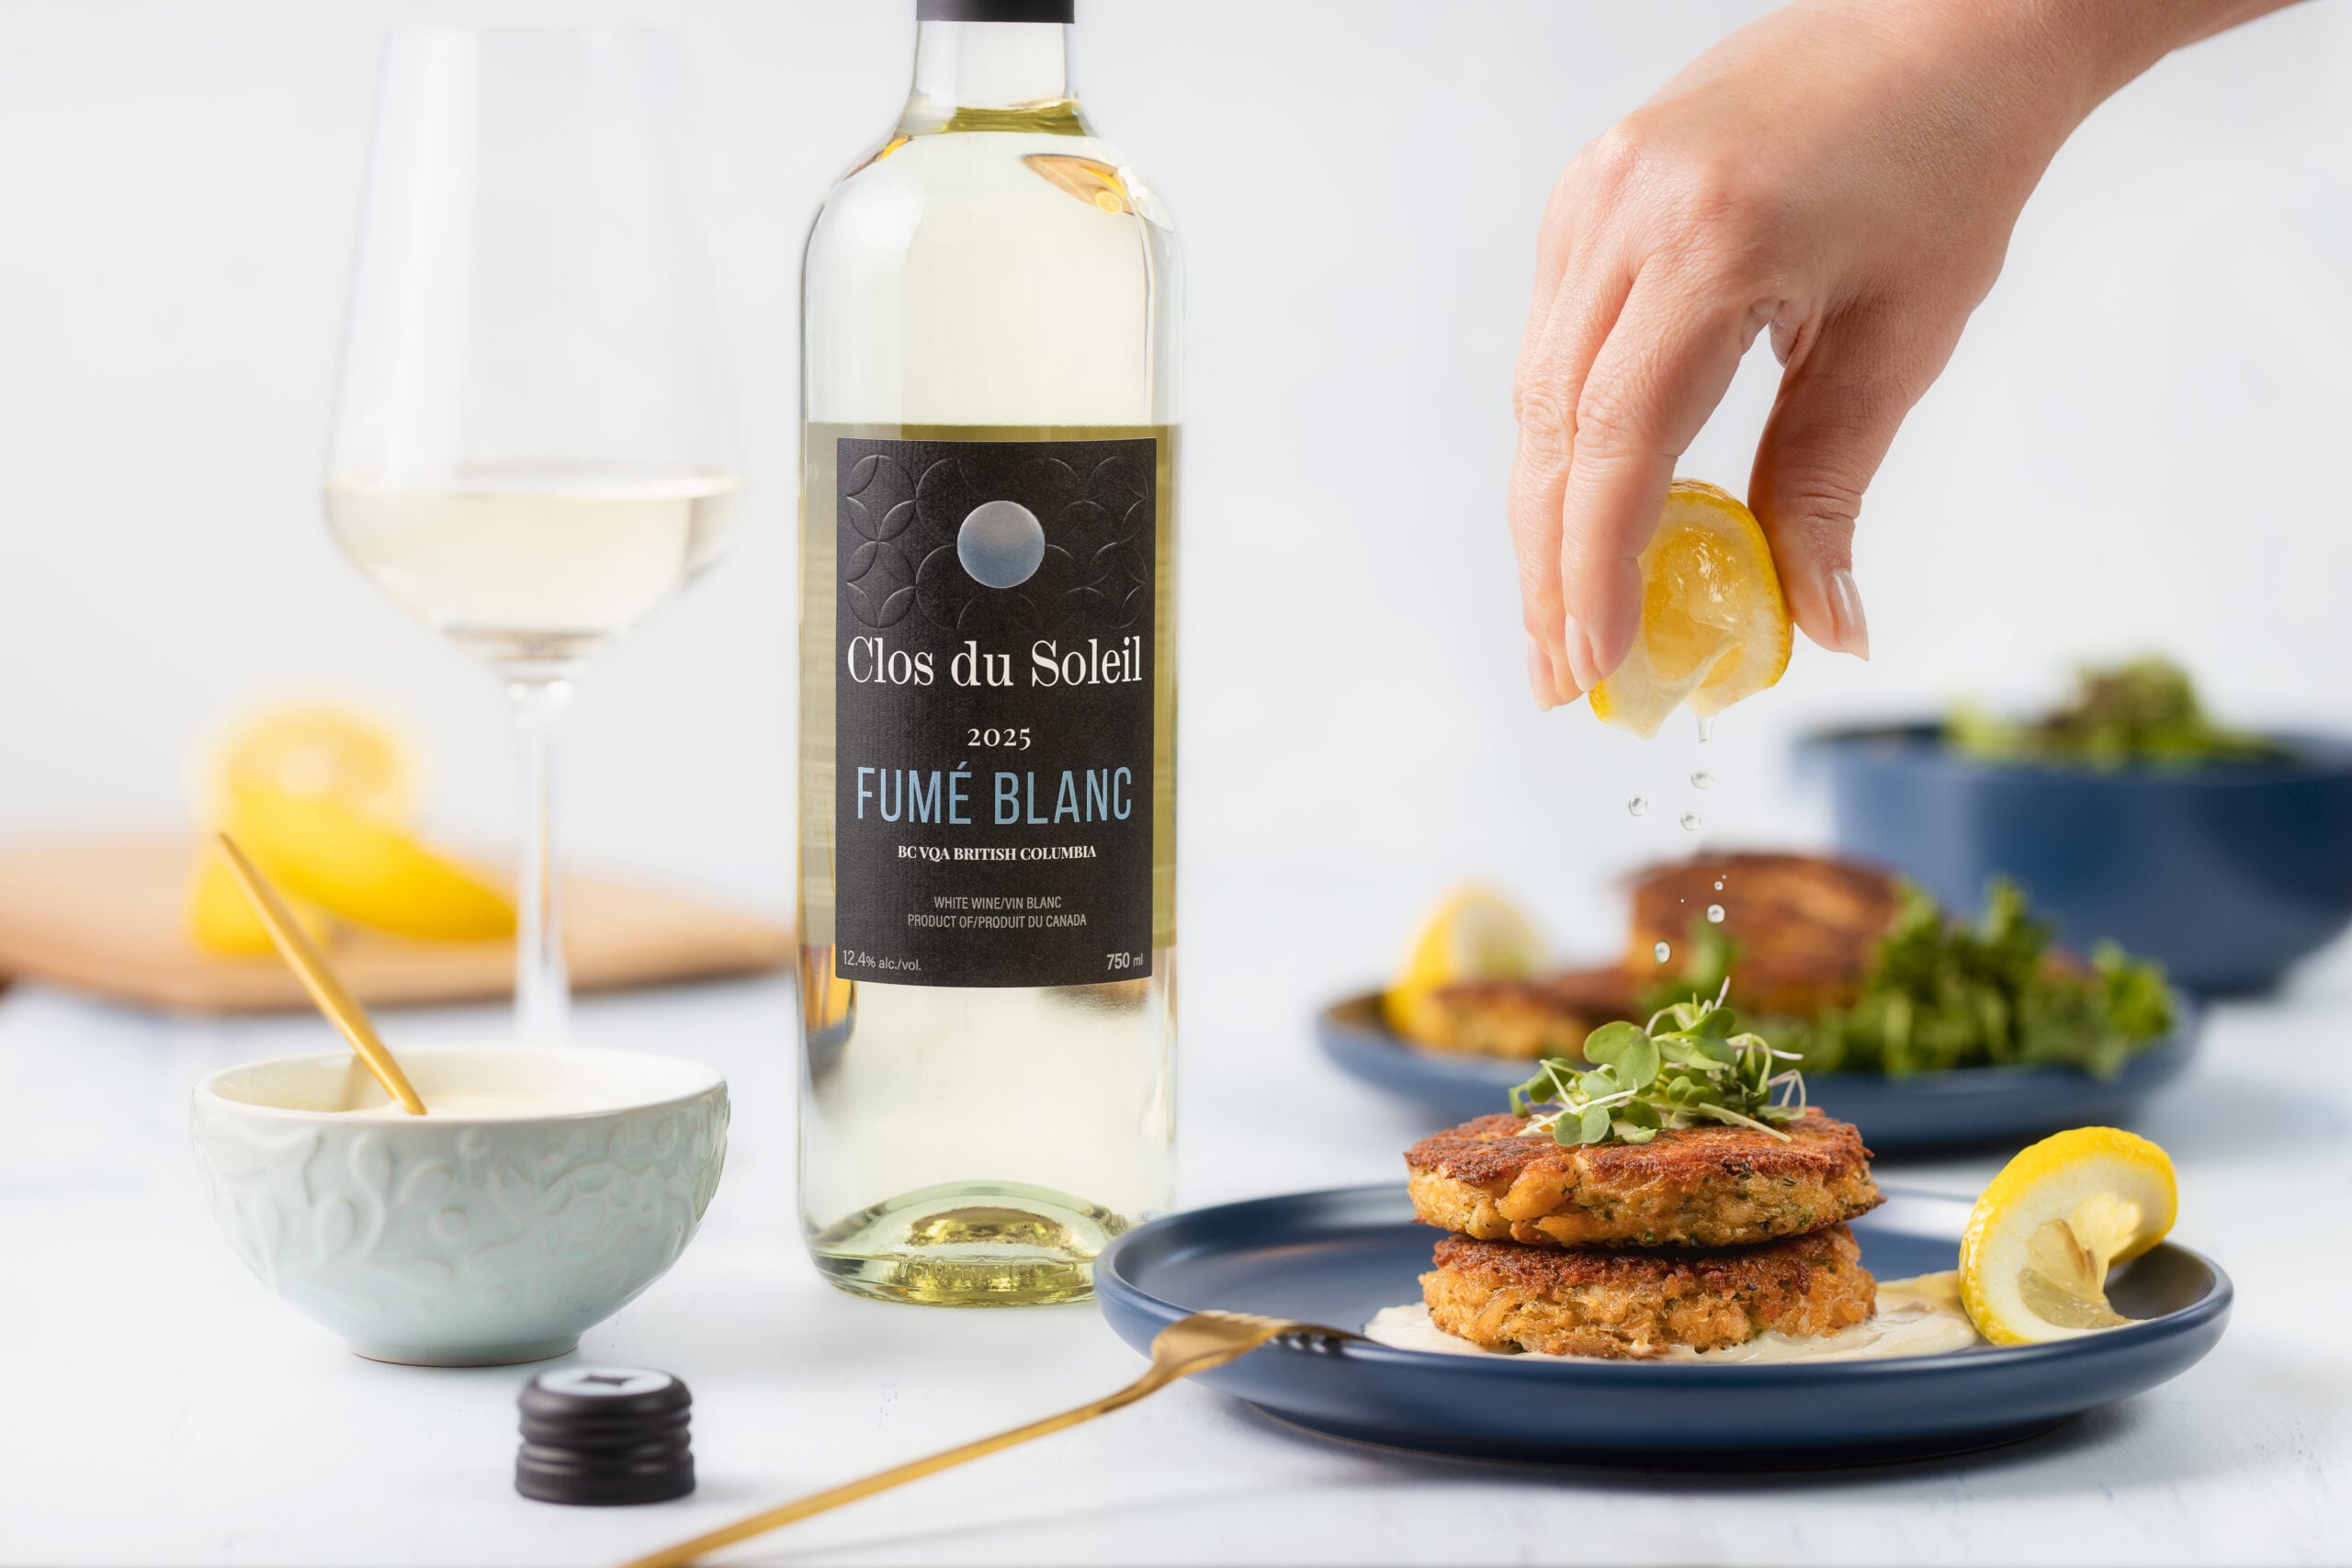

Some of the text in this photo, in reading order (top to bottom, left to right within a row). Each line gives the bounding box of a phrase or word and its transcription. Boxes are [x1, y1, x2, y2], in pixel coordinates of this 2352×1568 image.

[848, 636, 1141, 686] Clos du Soleil
[967, 728, 1031, 750] 2025
[858, 761, 1131, 824] FUMÉ BLANC
[899, 846, 1096, 862] BC VQA BRITISH COLUMBIA
[934, 897, 1061, 909] WHITE WINE/VIN BLANC
[908, 914, 1086, 928] PRODUCT OF/PRODUIT DU CANADA
[842, 950, 921, 970] 12.4% alc./vol.
[1106, 953, 1143, 969] 750 ml
